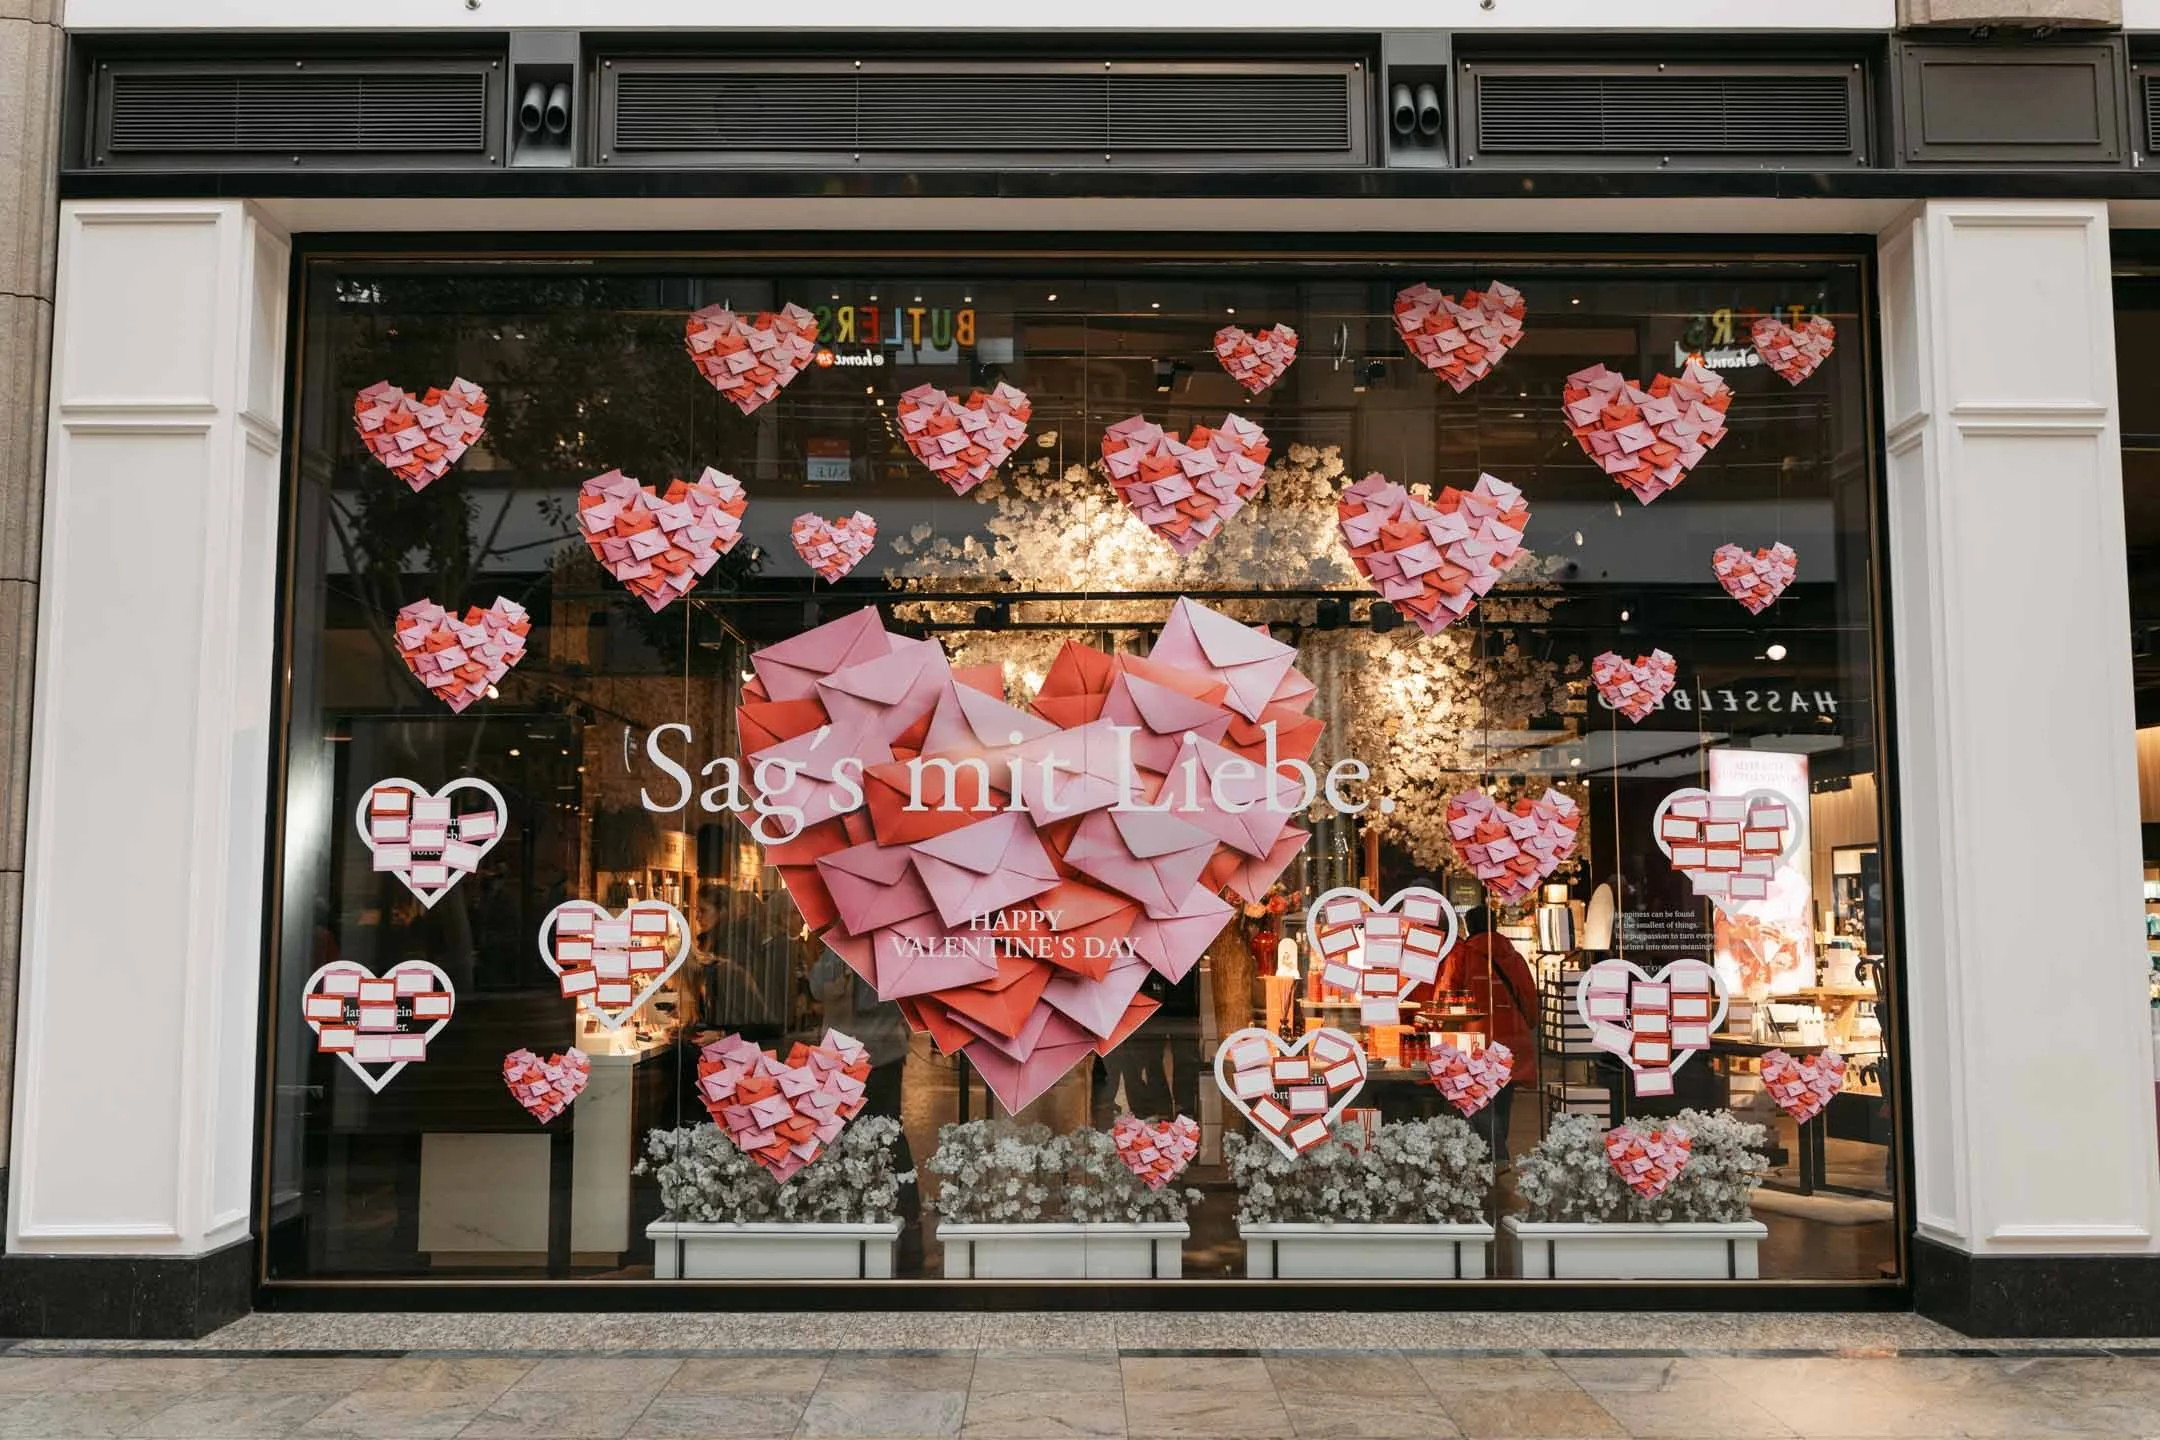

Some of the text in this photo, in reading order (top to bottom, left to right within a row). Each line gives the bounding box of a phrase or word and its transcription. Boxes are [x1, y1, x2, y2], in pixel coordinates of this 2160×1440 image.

[902, 729, 1071, 813] mit
[1107, 720, 1395, 814] Liebe.
[969, 909, 1065, 931] HAPPY
[1665, 910, 1673, 918] be
[1675, 910, 1695, 918] found
[1636, 920, 1665, 929] smallest
[889, 936, 1142, 959] VALENTINE'S DAY
[1661, 943, 1679, 951] more
